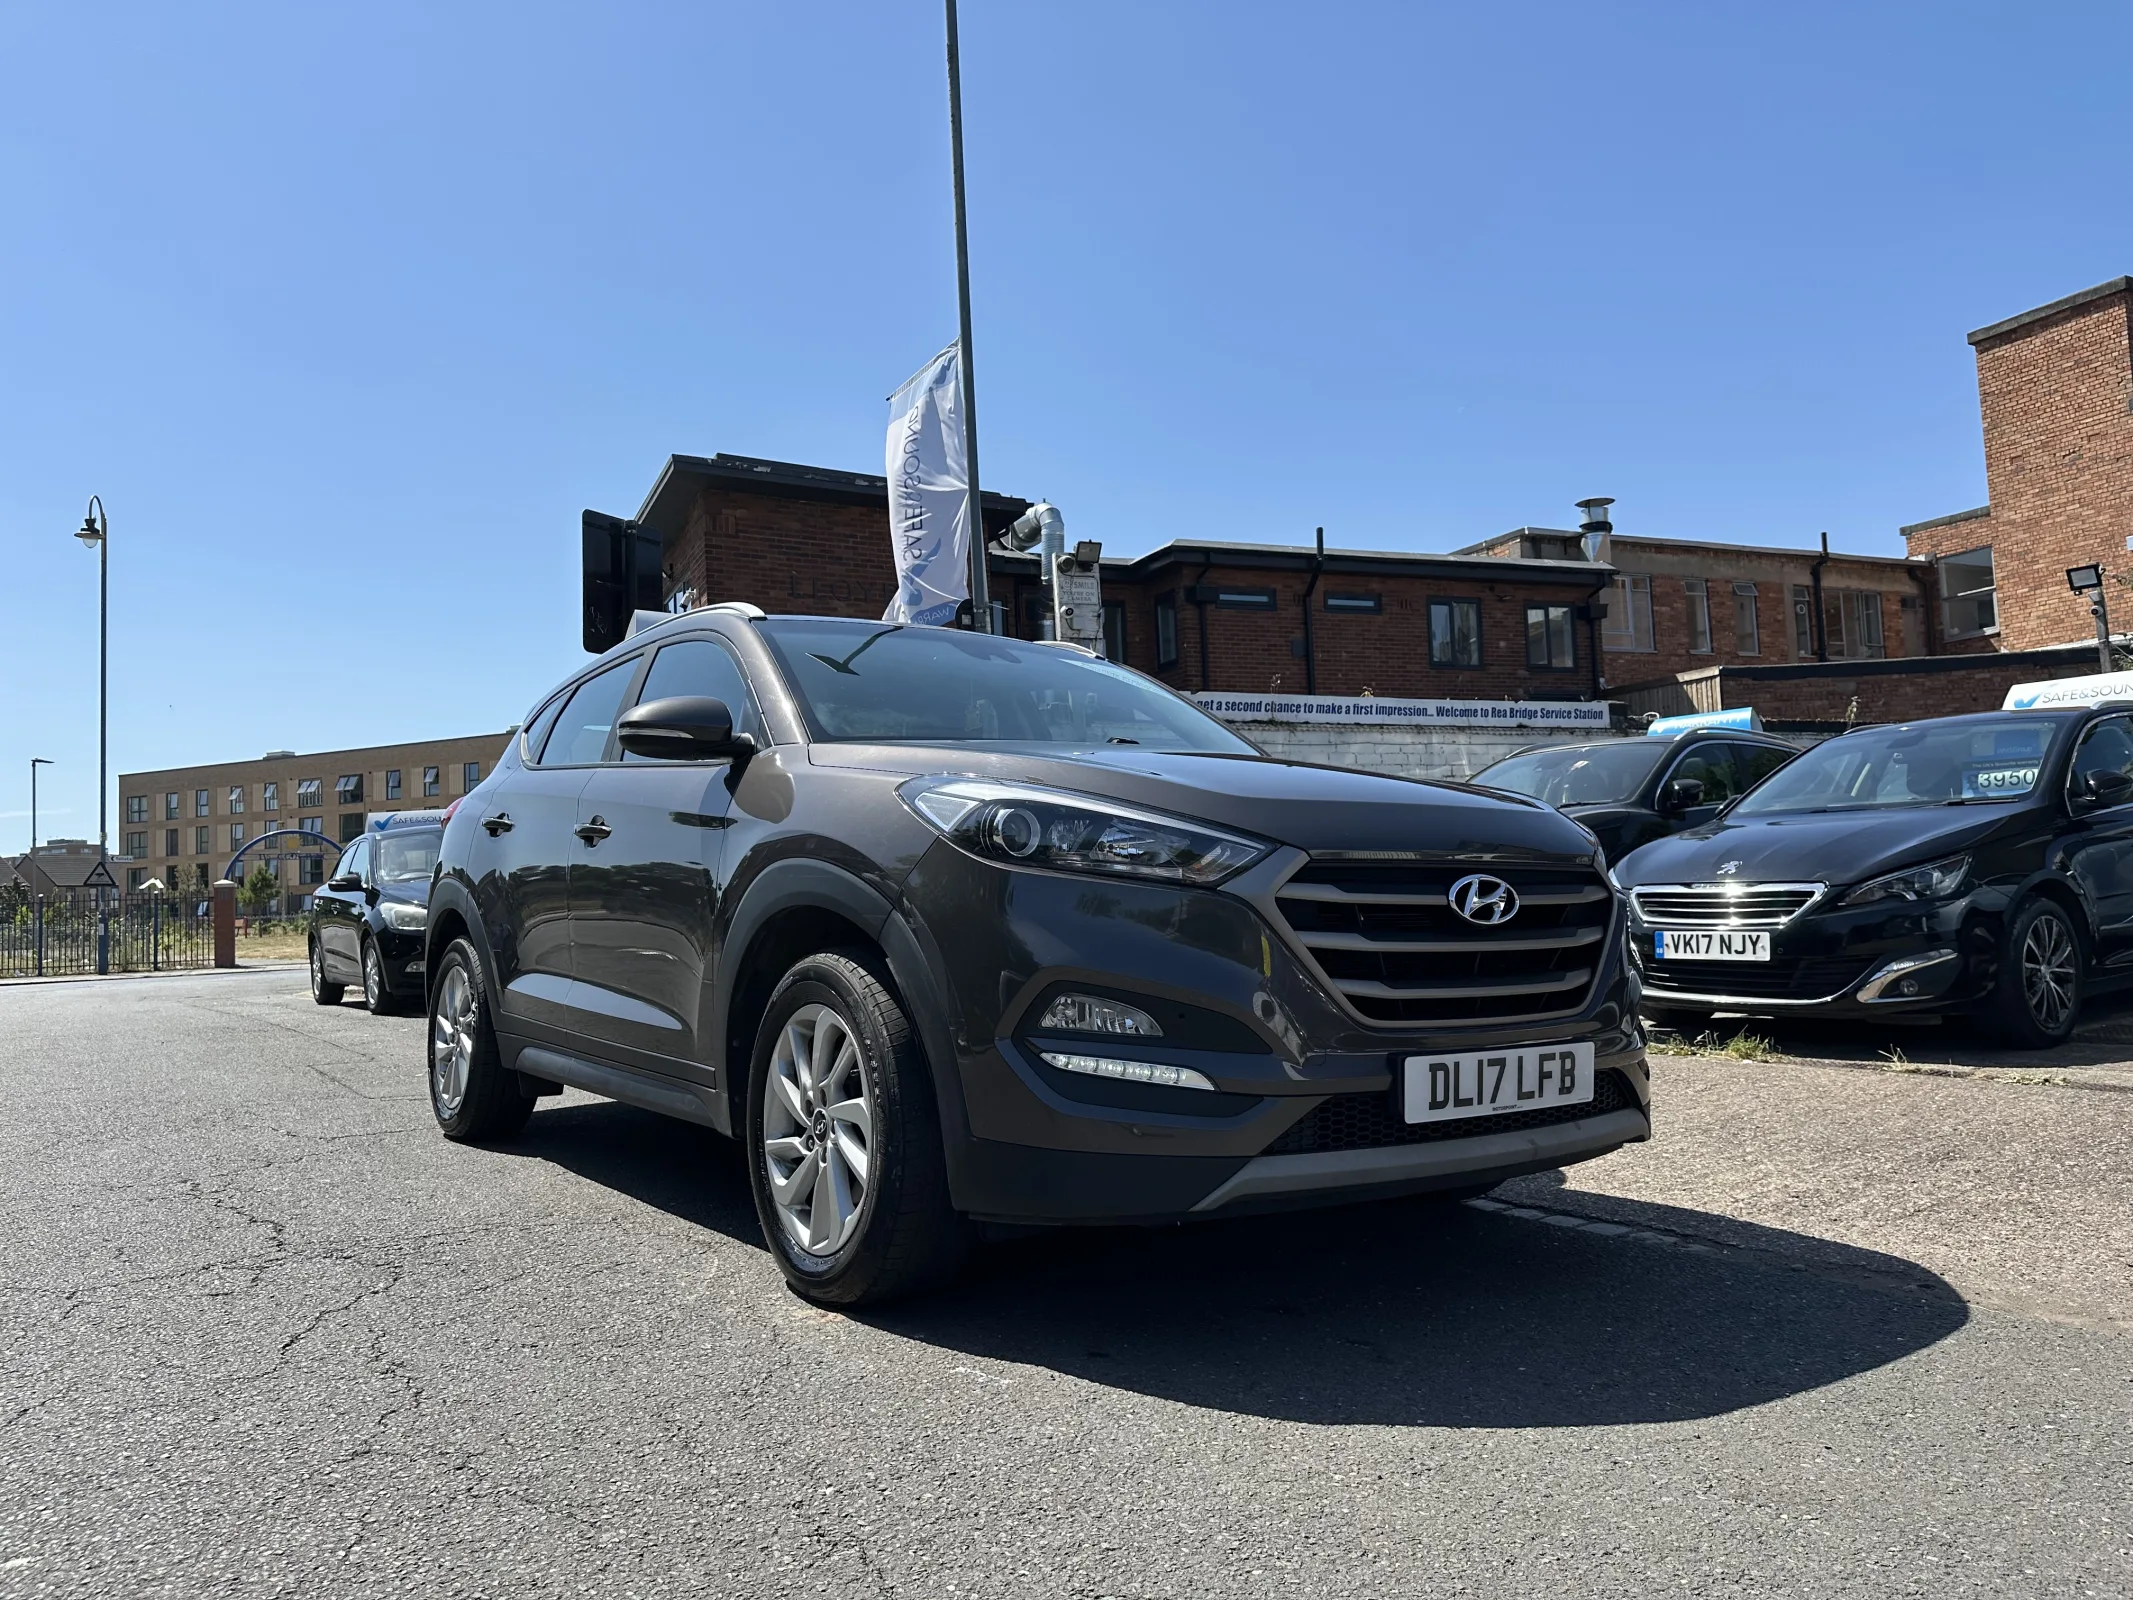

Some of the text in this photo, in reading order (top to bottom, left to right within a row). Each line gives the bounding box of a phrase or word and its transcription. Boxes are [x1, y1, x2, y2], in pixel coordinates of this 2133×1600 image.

[1074, 581, 1095, 589] SMILE
[1216, 701, 1223, 711] a
[1224, 700, 1263, 713] second
[1264, 702, 1301, 713] chance
[1303, 704, 1314, 714] to
[1316, 703, 1343, 715] make
[1345, 705, 1351, 715] a
[1352, 704, 1374, 716] first
[1436, 706, 1478, 718] Welcome
[1480, 708, 1490, 718] to
[1491, 708, 1507, 719] Rea
[1509, 707, 1539, 720] Bridge
[1540, 708, 1572, 720] Service
[1574, 708, 1604, 720] Station
[1670, 934, 1761, 955] VK17 NJY
[1428, 1051, 1576, 1111] DL17 LFB
